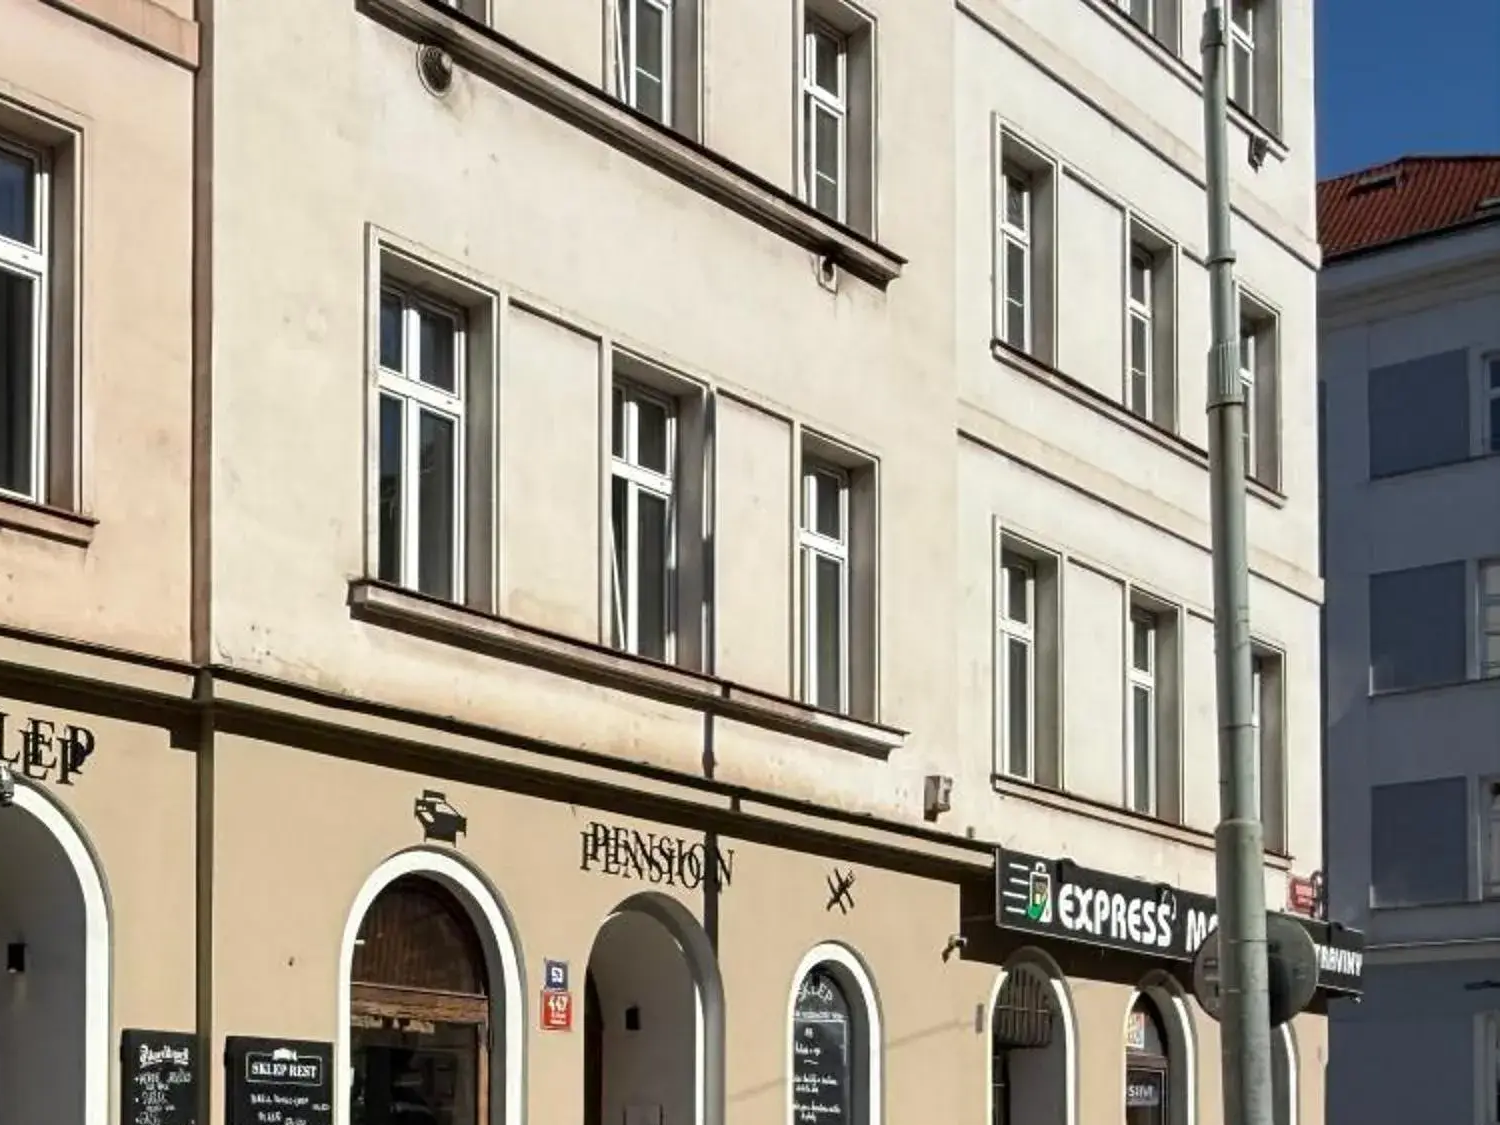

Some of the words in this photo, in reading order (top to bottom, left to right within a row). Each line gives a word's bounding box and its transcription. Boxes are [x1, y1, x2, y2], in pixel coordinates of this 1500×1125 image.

[588, 821, 736, 887] PENSION
[1058, 883, 1173, 948] EXPRESS
[1313, 943, 1364, 977] TRAVINY
[251, 1061, 288, 1077] SKLEP
[288, 1064, 318, 1080] REST
